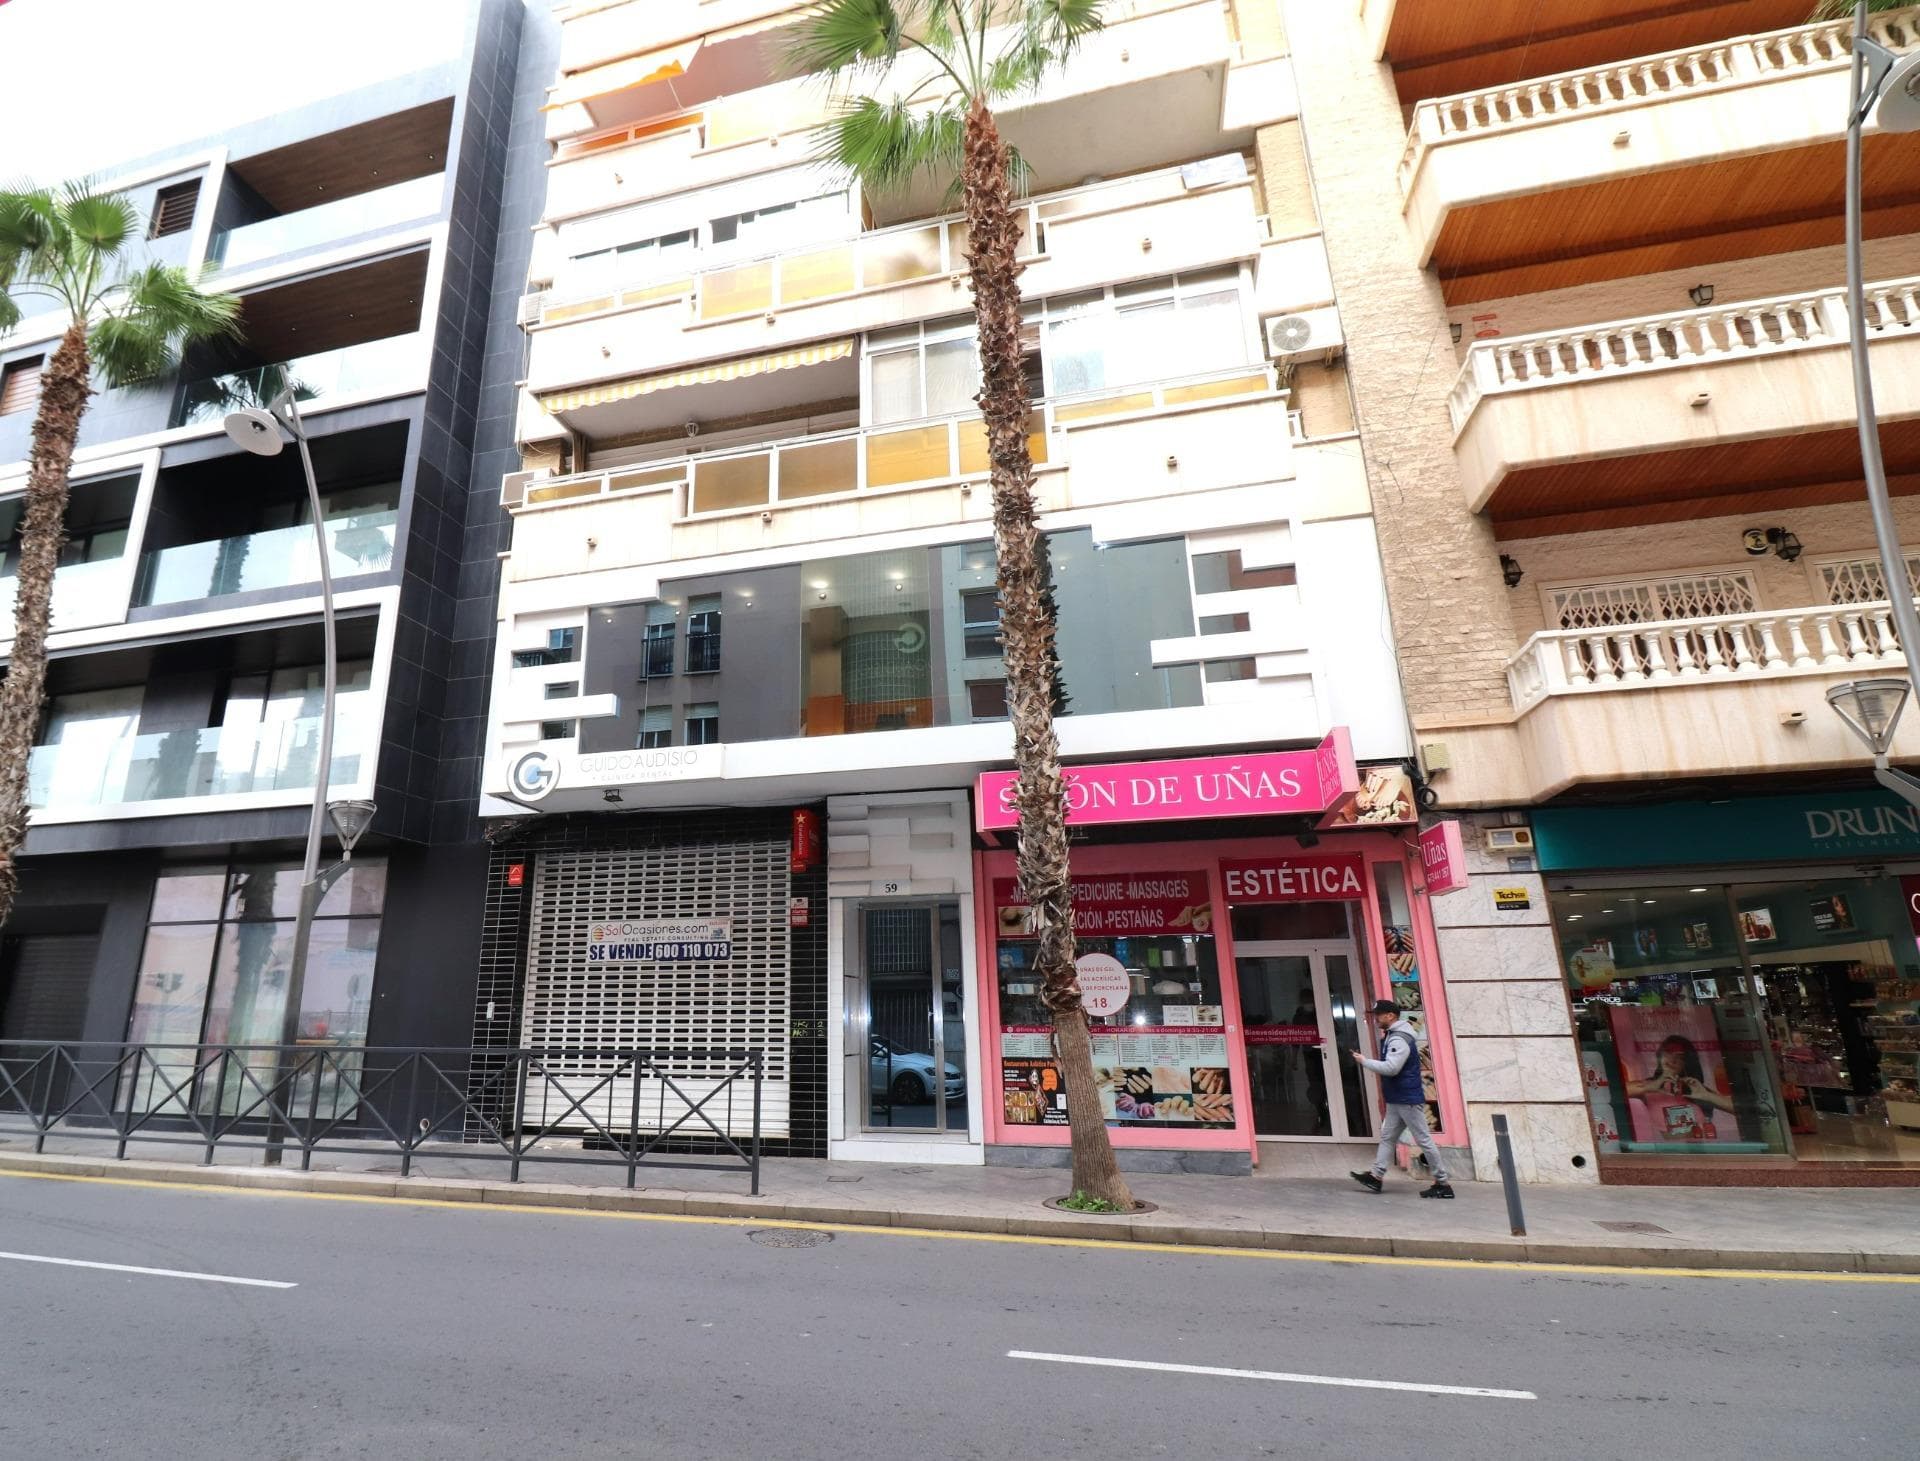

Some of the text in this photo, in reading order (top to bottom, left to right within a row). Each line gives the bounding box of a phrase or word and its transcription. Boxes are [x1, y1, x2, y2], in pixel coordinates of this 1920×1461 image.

[999, 766, 1300, 814] SÓN DE UÑAS
[1805, 805, 1920, 839] DRUN
[1422, 841, 1447, 867] Uñas
[885, 883, 898, 893] 59
[1226, 862, 1362, 896] ESTÉTICA
[605, 922, 709, 936] SolOcasiones.com
[589, 942, 728, 960] SE VENDE 600 110 073
[1092, 997, 1107, 1008] 18
